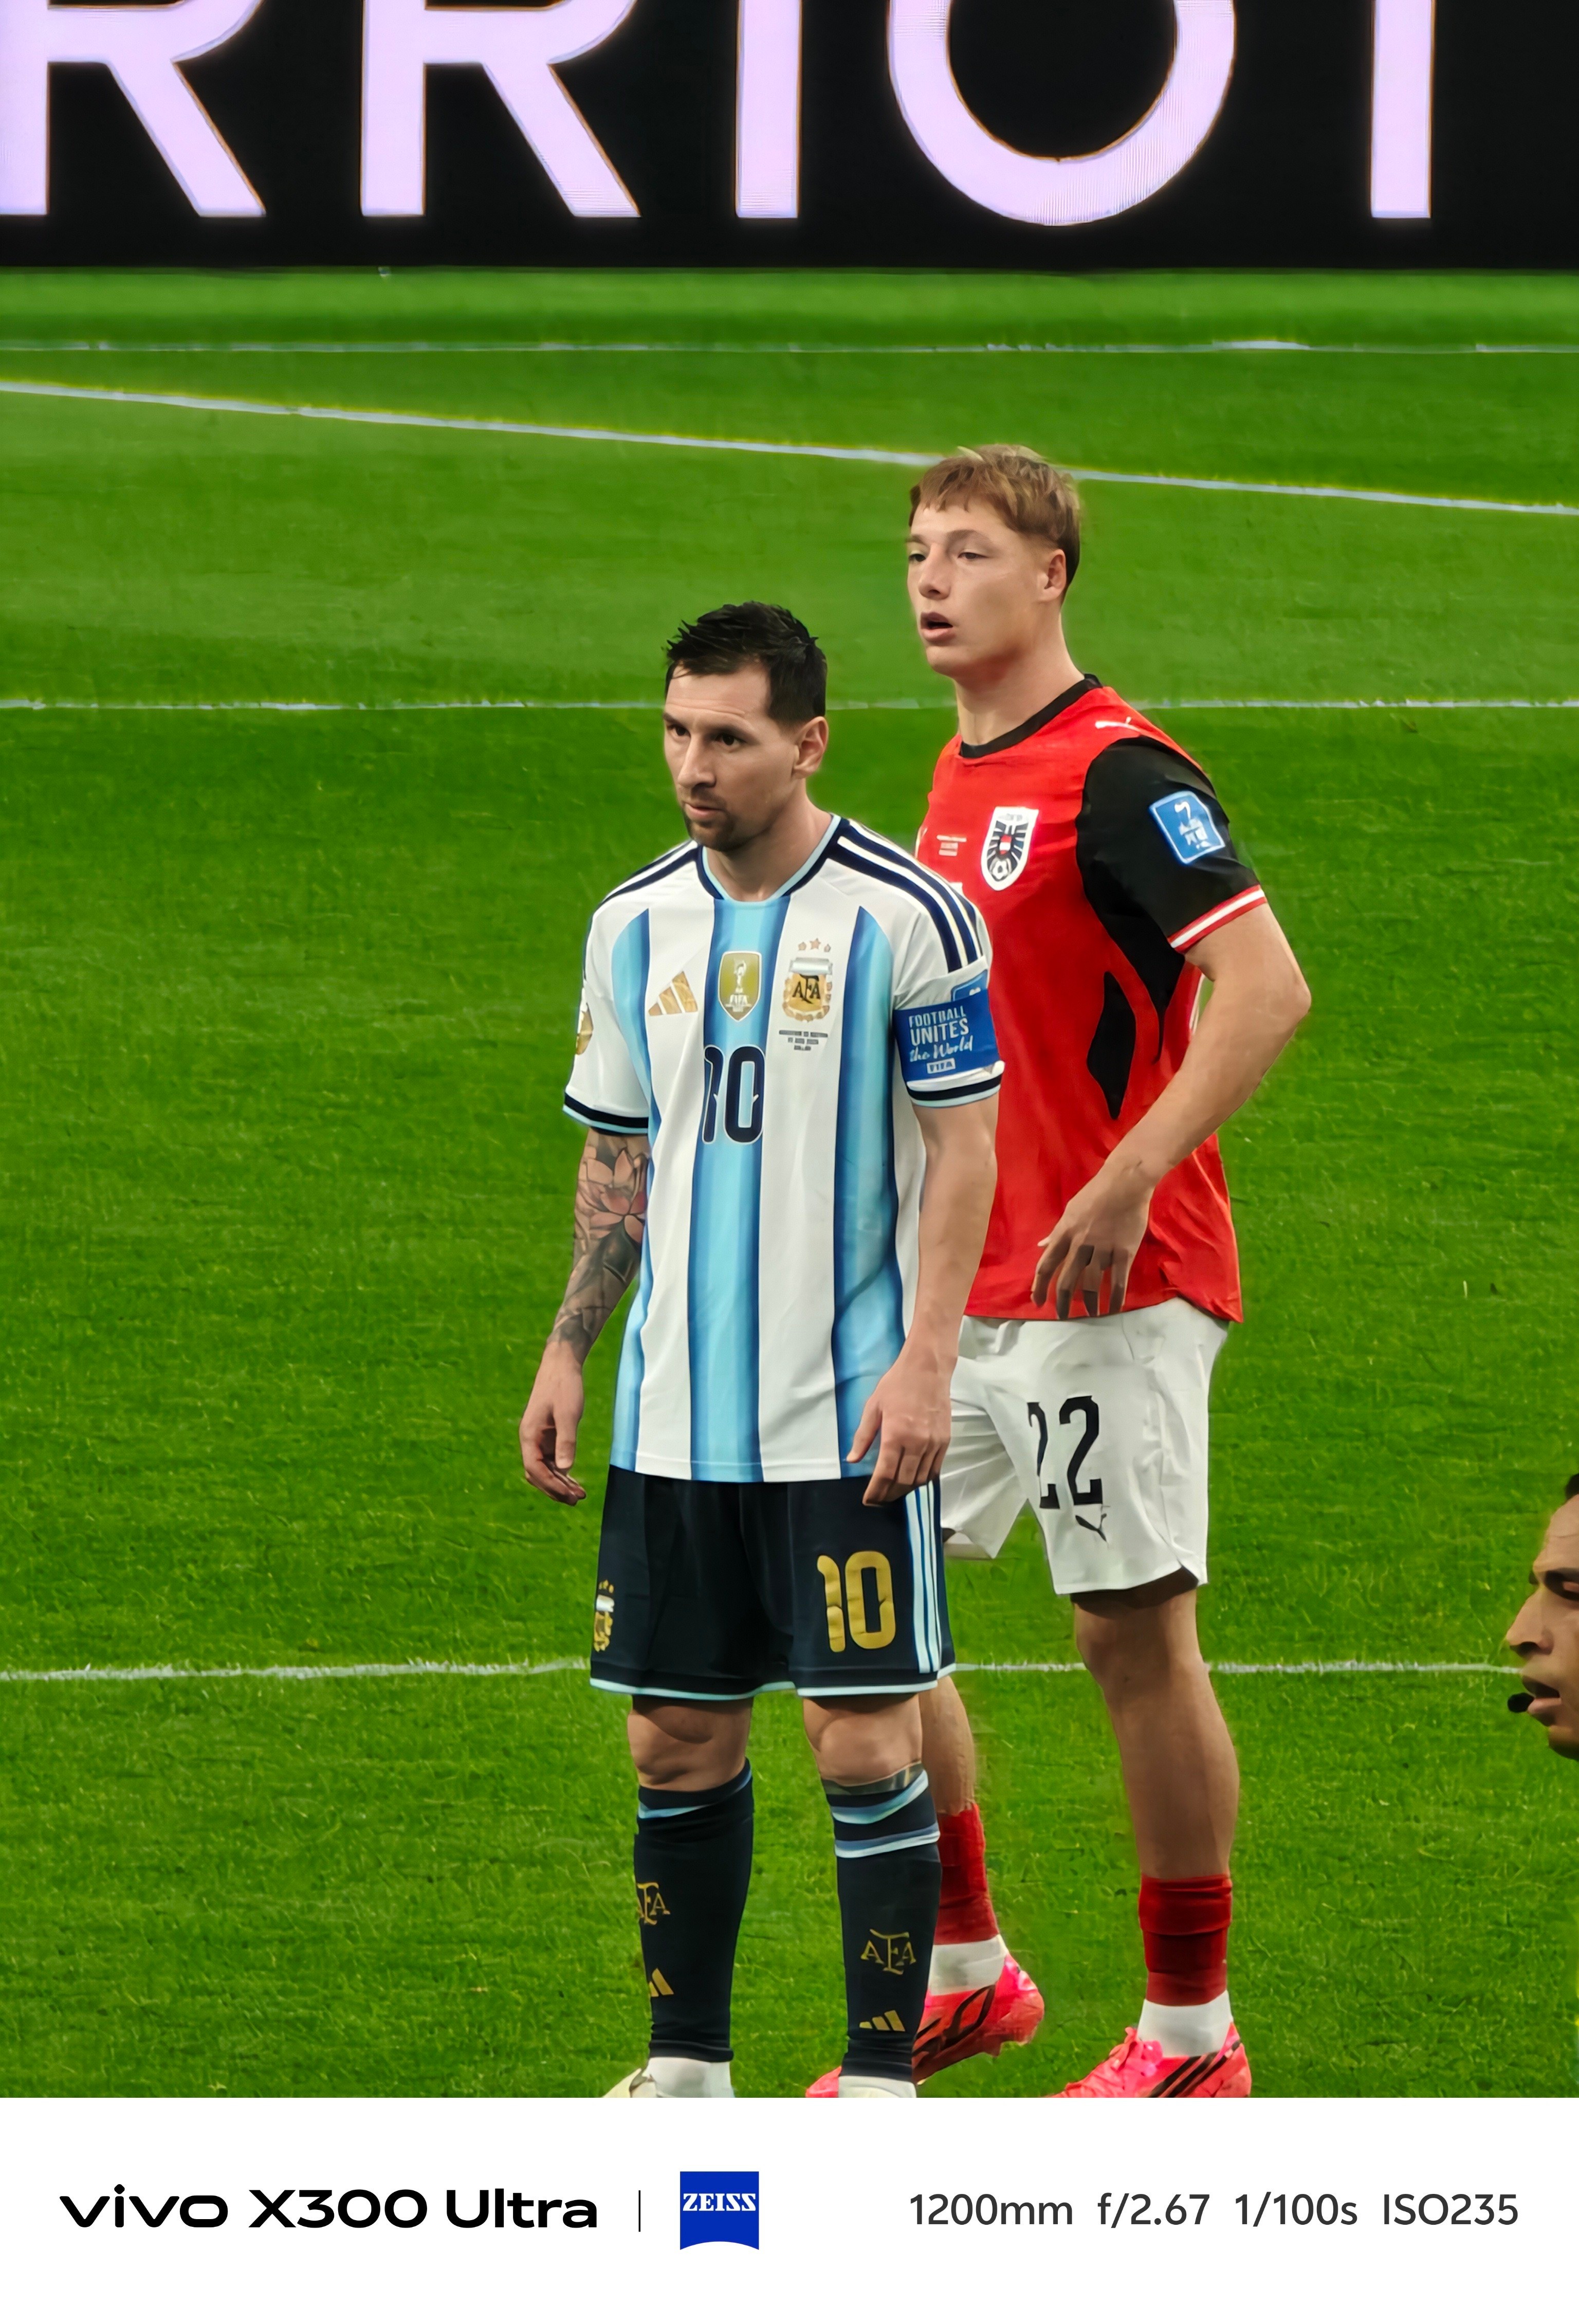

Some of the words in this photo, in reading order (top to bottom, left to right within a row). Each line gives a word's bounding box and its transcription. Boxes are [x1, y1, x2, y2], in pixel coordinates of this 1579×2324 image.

[792, 973, 821, 1005] AFA
[909, 1005, 966, 1028] FOOTBALL
[910, 1018, 969, 1046] UNITES
[933, 1034, 974, 1059] World
[703, 1045, 765, 1143] 10
[1027, 1395, 1103, 1510] 22
[817, 1550, 896, 1653] 10
[860, 1929, 916, 1975] AFA
